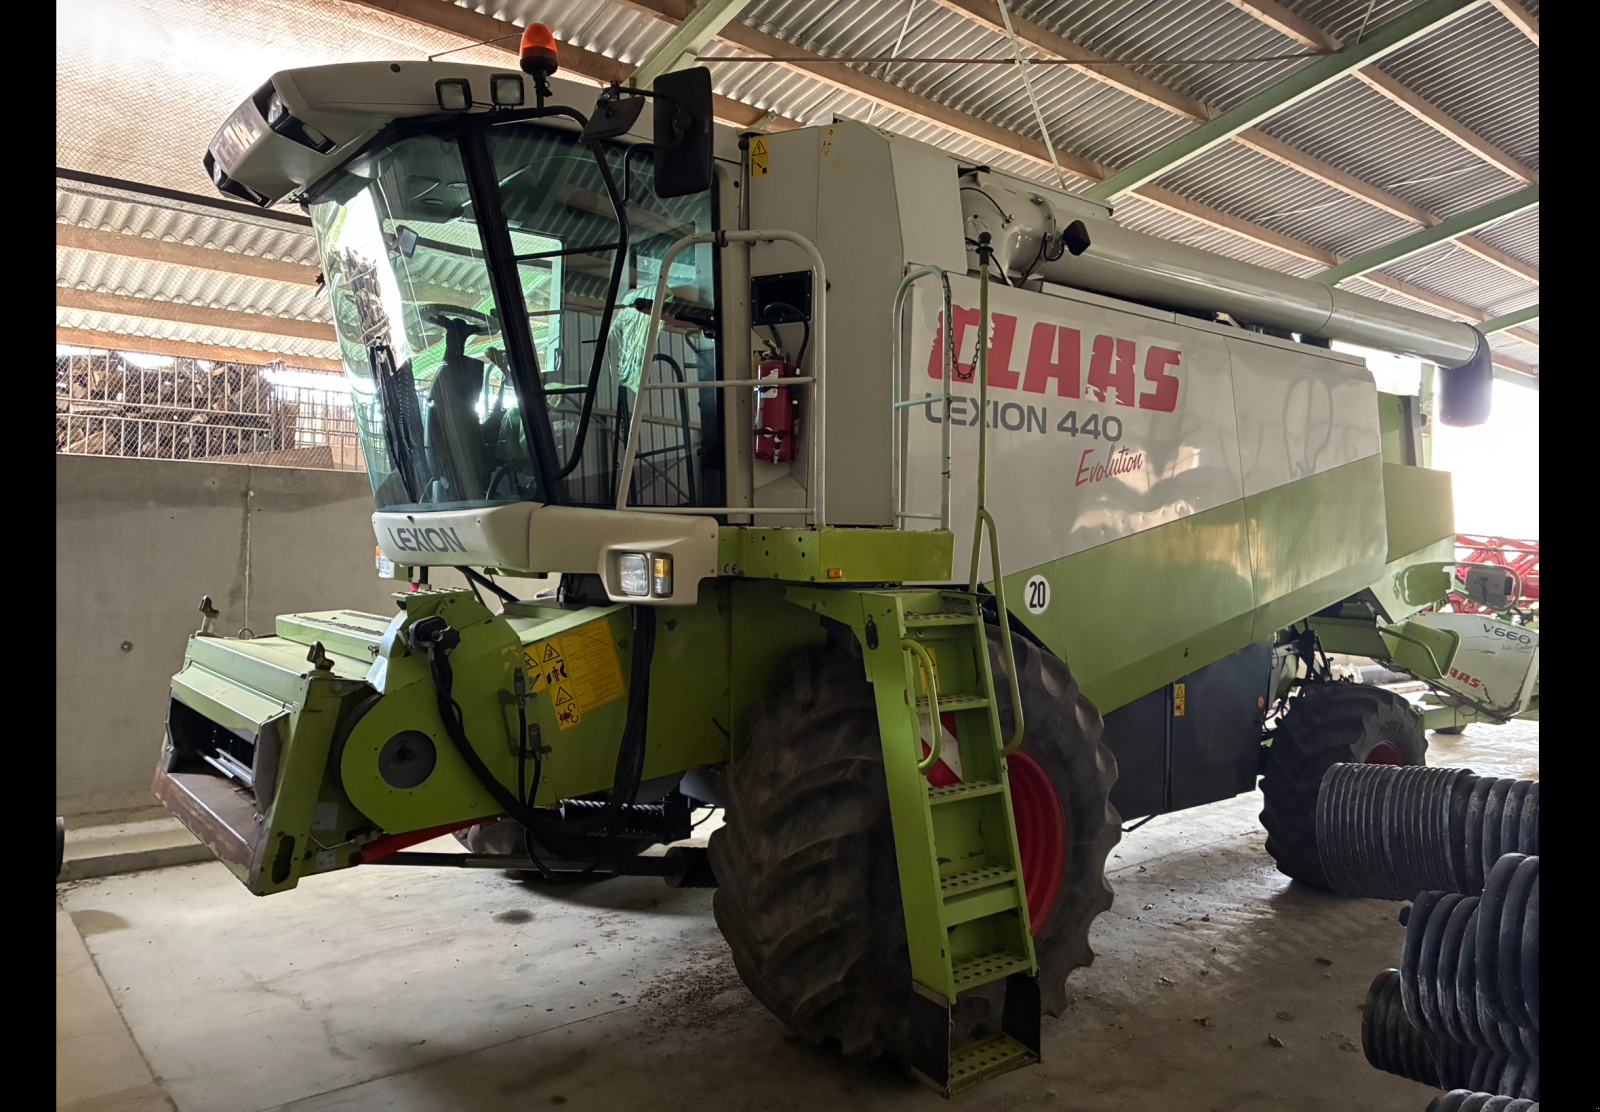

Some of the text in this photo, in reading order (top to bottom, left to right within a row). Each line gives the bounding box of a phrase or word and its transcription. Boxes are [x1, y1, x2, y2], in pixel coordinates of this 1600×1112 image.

[927, 304, 1182, 413] CLAAS
[925, 393, 1123, 442] LEXION 440
[1075, 443, 1143, 487] Evolution
[387, 527, 468, 553] LEXION
[1029, 580, 1046, 609] 20
[1483, 623, 1531, 644] V660
[1449, 667, 1482, 689] AAS
